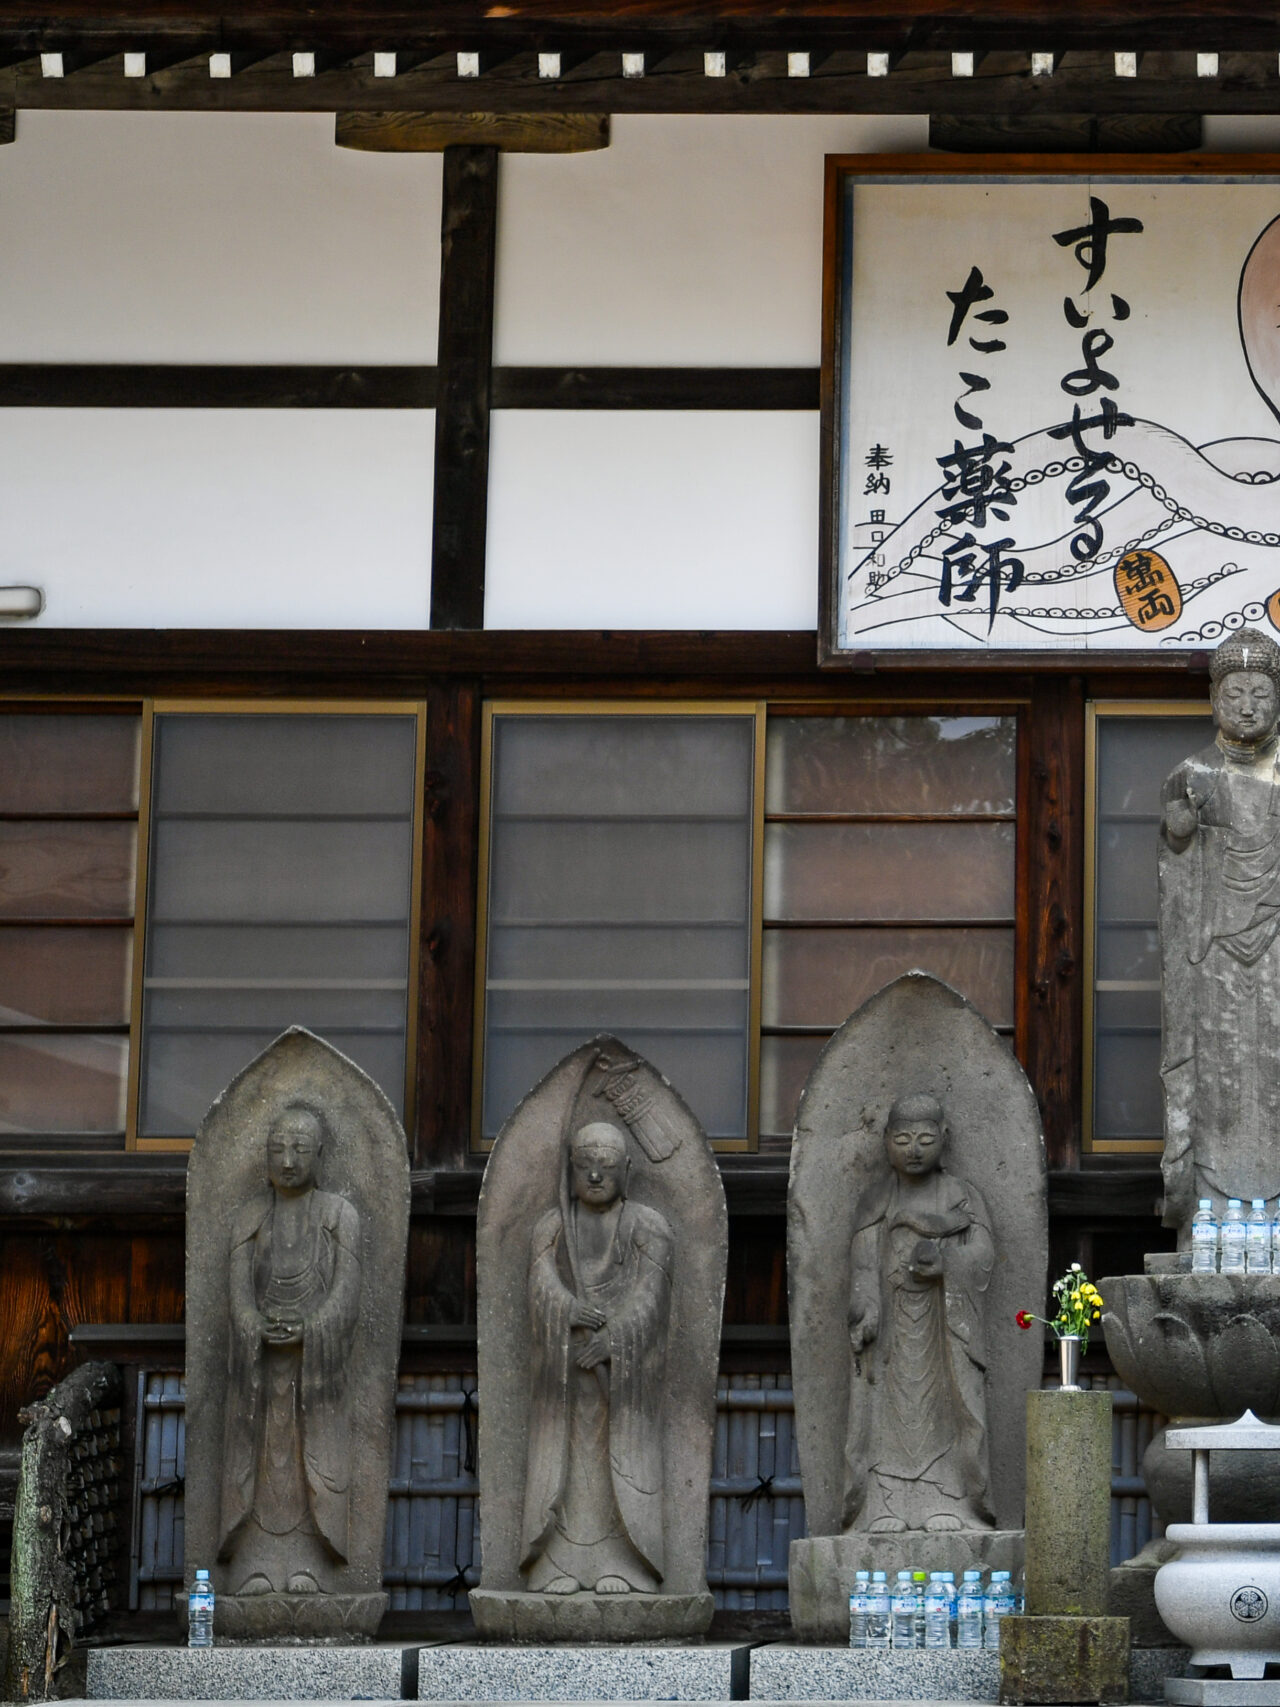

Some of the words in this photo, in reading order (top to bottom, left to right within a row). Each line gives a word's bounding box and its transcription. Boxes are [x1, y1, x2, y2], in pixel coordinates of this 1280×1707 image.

[863, 443, 894, 496] 奉納
[935, 266, 1024, 636] たこ薬師
[1047, 196, 1144, 561] すいよせる
